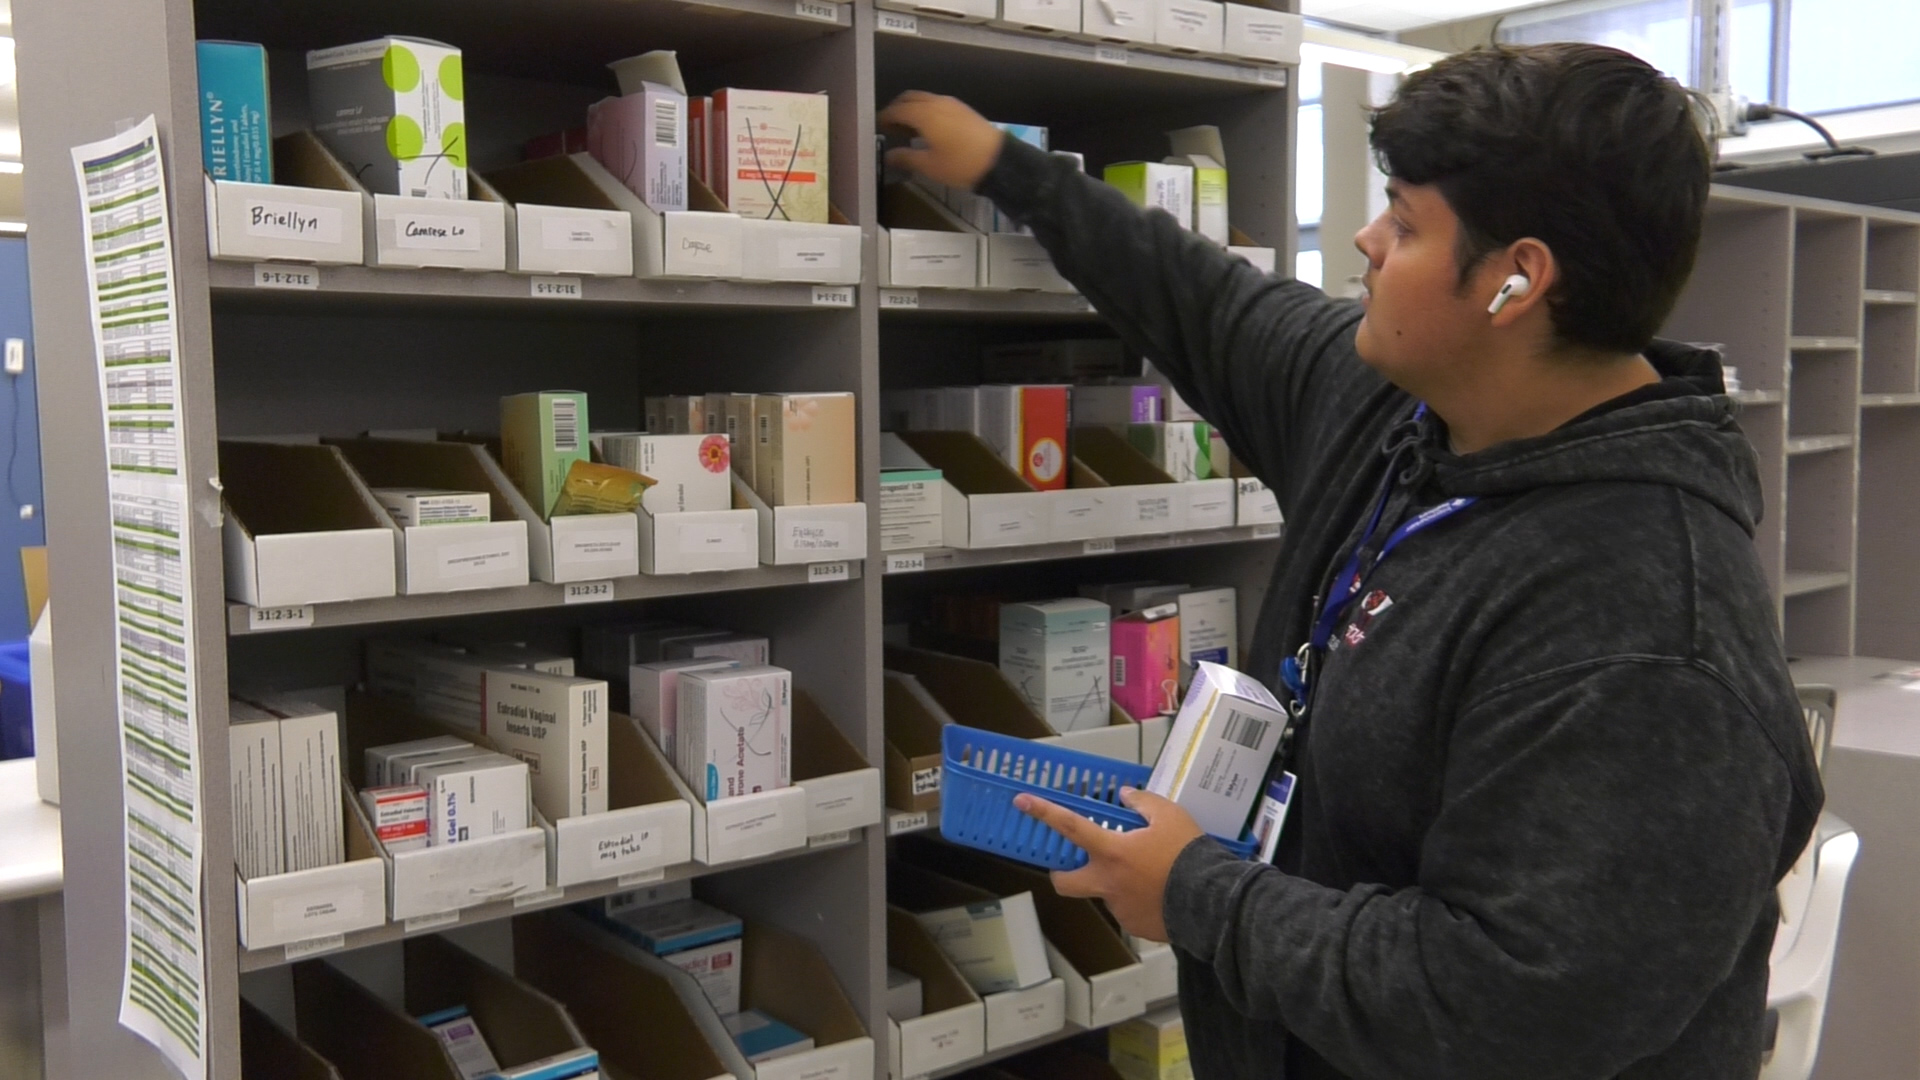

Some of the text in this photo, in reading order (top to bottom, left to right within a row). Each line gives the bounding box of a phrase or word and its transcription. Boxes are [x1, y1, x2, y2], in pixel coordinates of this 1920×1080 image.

[251, 206, 317, 233] Briellyn
[452, 226, 465, 236] Lo
[262, 272, 310, 285] 31:2-1-6
[537, 284, 577, 295] 31:2-1-5
[813, 565, 844, 576] 31:2-3-3
[570, 585, 608, 597] 31:2-3-2
[257, 608, 304, 621] 31:2-3-1
[497, 701, 556, 724] Estradiol Vaginal
[531, 725, 547, 739] USP
[736, 726, 745, 767] Acetate
[726, 777, 735, 796] and
[447, 792, 456, 836] Gel 0.1%
[621, 844, 641, 856] tabs
